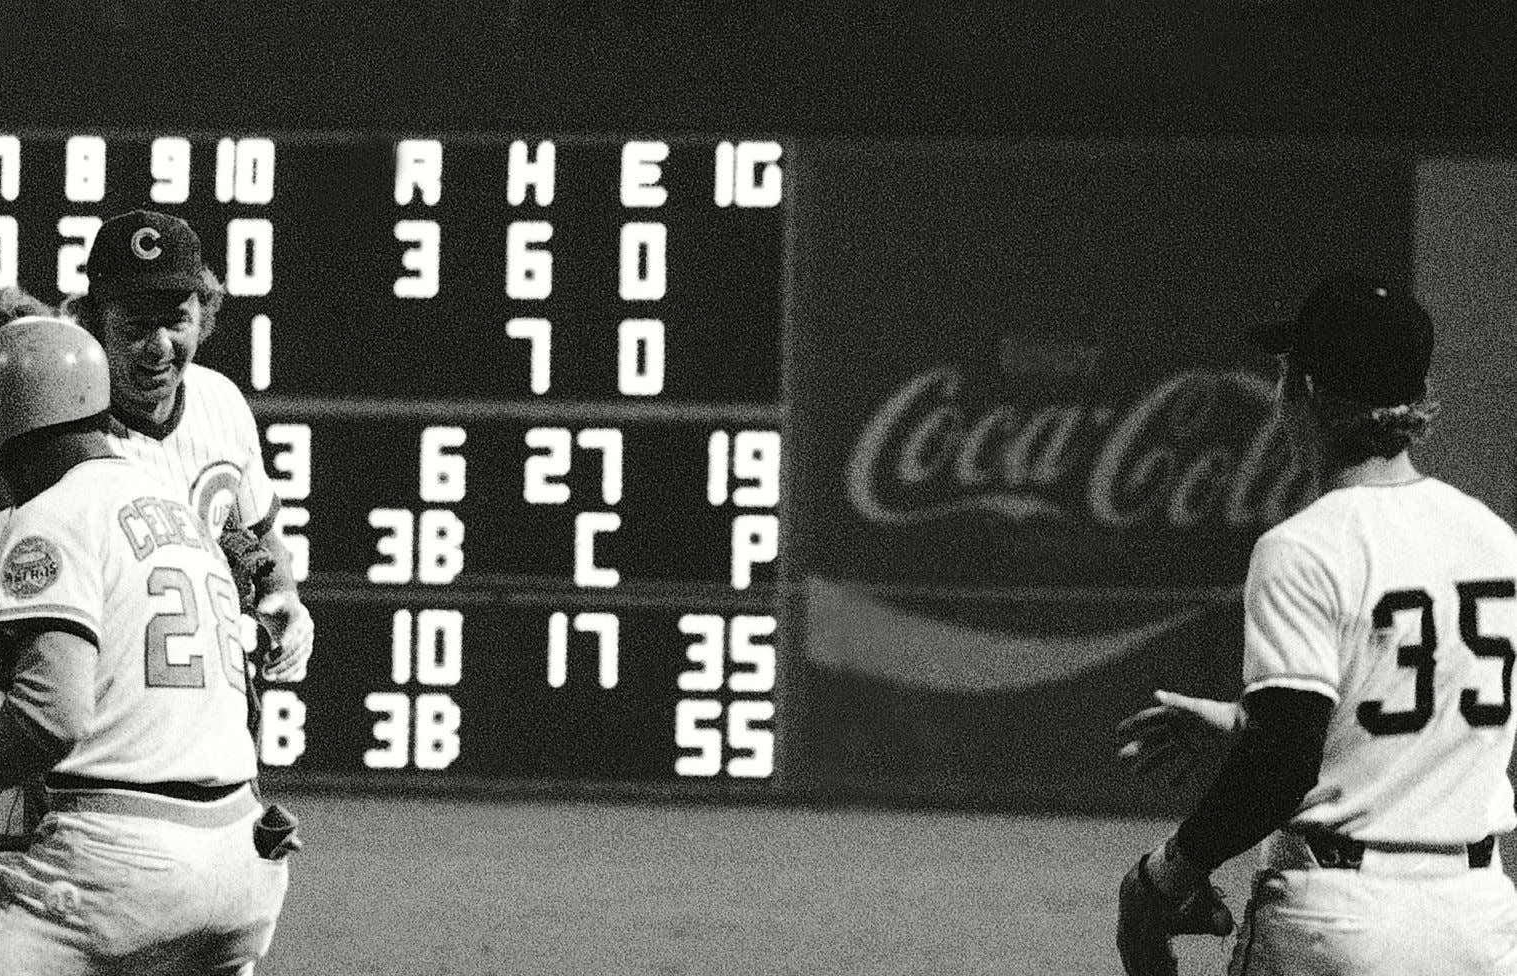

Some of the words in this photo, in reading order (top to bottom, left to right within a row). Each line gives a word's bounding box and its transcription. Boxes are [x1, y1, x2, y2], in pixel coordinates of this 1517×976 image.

[65, 135, 106, 202] 8
[151, 136, 191, 203] 9
[216, 137, 275, 204] 10
[395, 139, 442, 205] R
[507, 140, 555, 206] H
[620, 141, 669, 207] E
[132, 227, 162, 260] C
[225, 219, 273, 296] 0
[394, 220, 440, 298] 3
[506, 221, 553, 299] 6
[619, 222, 667, 300] 0
[252, 315, 271, 390] 1
[506, 318, 551, 394] 7
[618, 319, 665, 395] 0
[420, 426, 466, 502] 6
[524, 428, 623, 504] 27
[708, 431, 782, 507] 19
[368, 509, 464, 584] 3B
[574, 512, 621, 588] C
[732, 515, 780, 590] P
[392, 609, 463, 685] 10
[548, 612, 619, 688] 17
[678, 614, 777, 692] 35
[1356, 579, 1516, 736] 35
[364, 693, 461, 769] 3B
